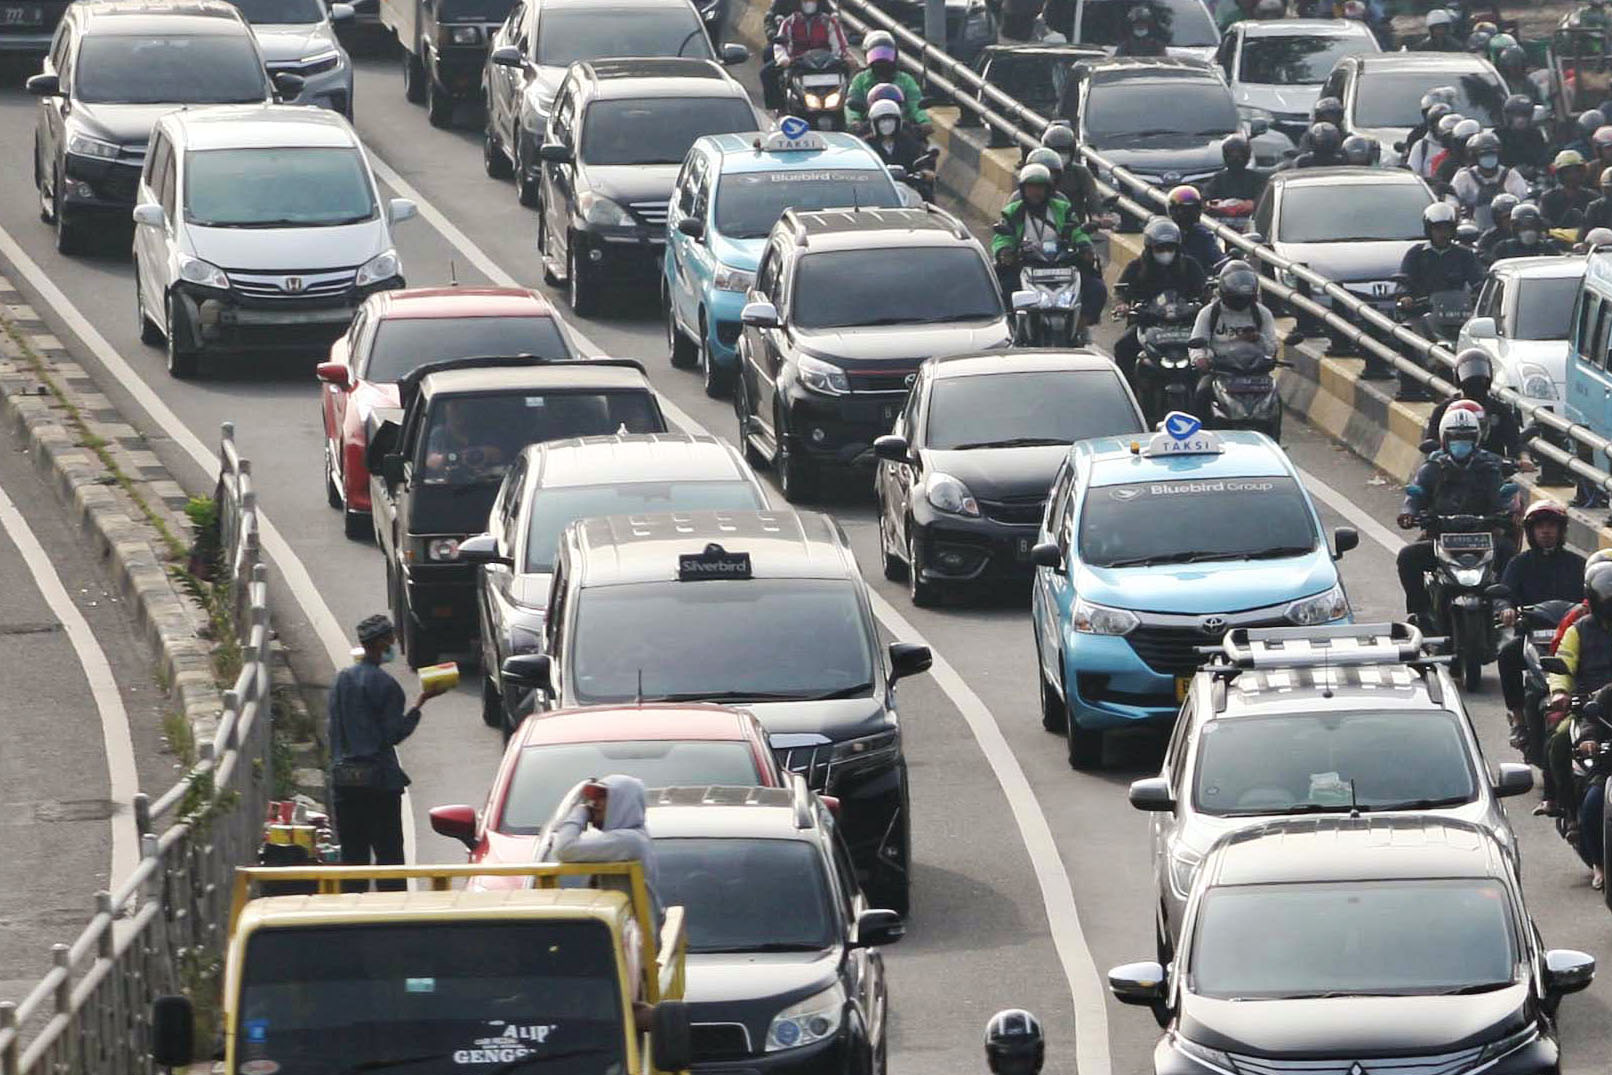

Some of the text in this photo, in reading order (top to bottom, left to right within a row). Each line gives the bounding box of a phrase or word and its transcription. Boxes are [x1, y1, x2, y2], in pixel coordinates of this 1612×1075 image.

[777, 139, 816, 149] TAKSI
[771, 173, 869, 186] Bluebird Group
[1163, 441, 1210, 452] TAKSI
[1151, 481, 1273, 495] Bluebird Group
[1020, 539, 1027, 552] B
[682, 560, 748, 574] Silverbird
[502, 1024, 557, 1043] ALIP
[454, 1049, 537, 1064] GENGS
